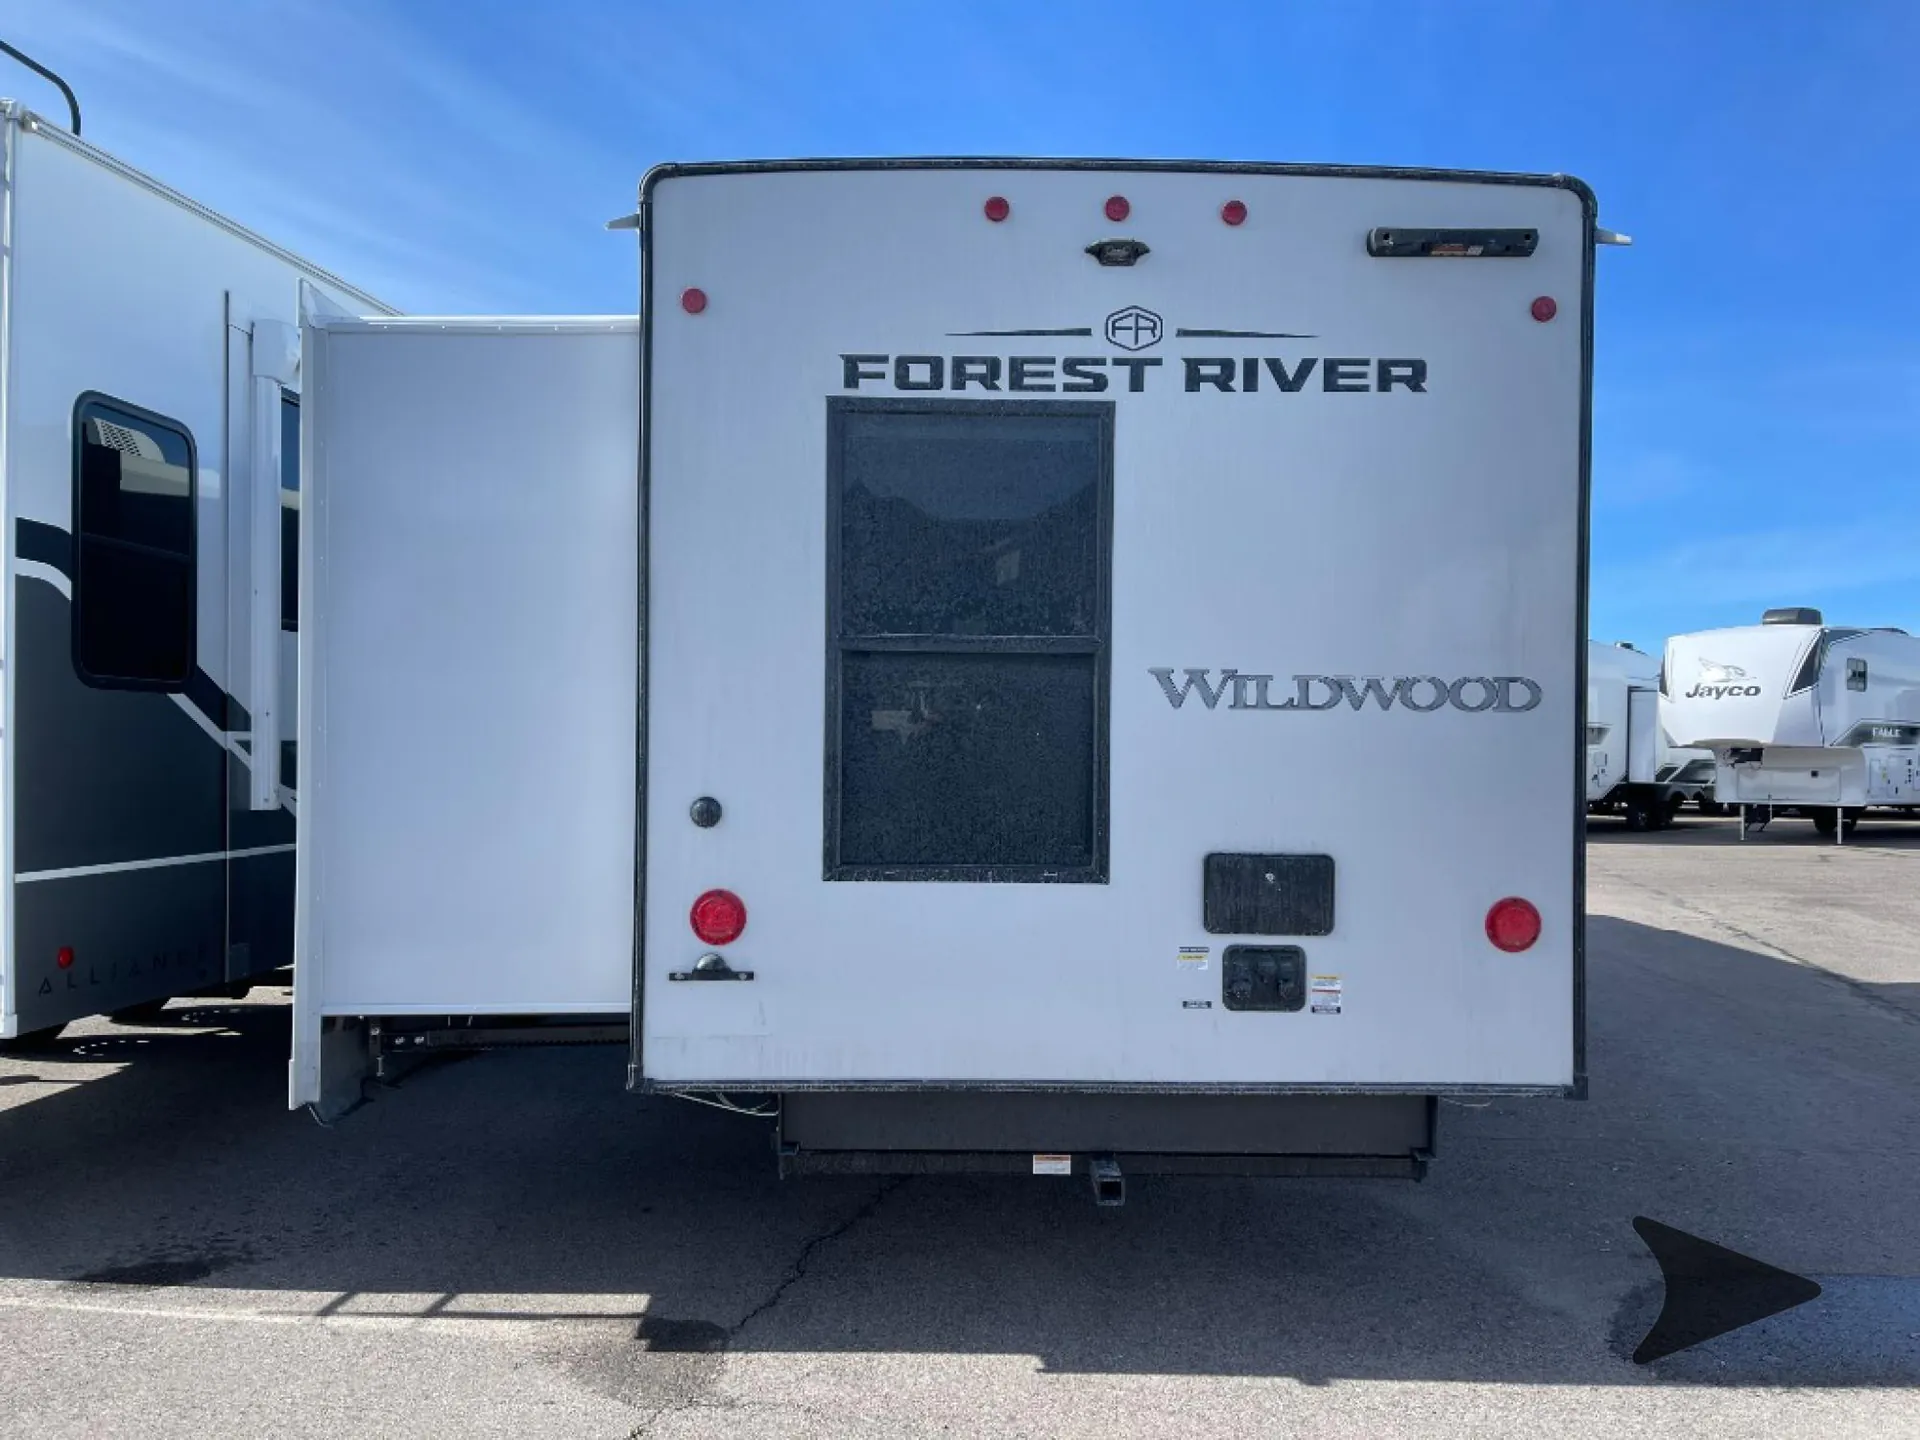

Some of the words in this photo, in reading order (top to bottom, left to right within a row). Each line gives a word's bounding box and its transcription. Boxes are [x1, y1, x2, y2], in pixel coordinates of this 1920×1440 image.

[838, 353, 1163, 393] FOREST
[1180, 356, 1428, 393] RIVER
[1685, 682, 1762, 700] Jayco
